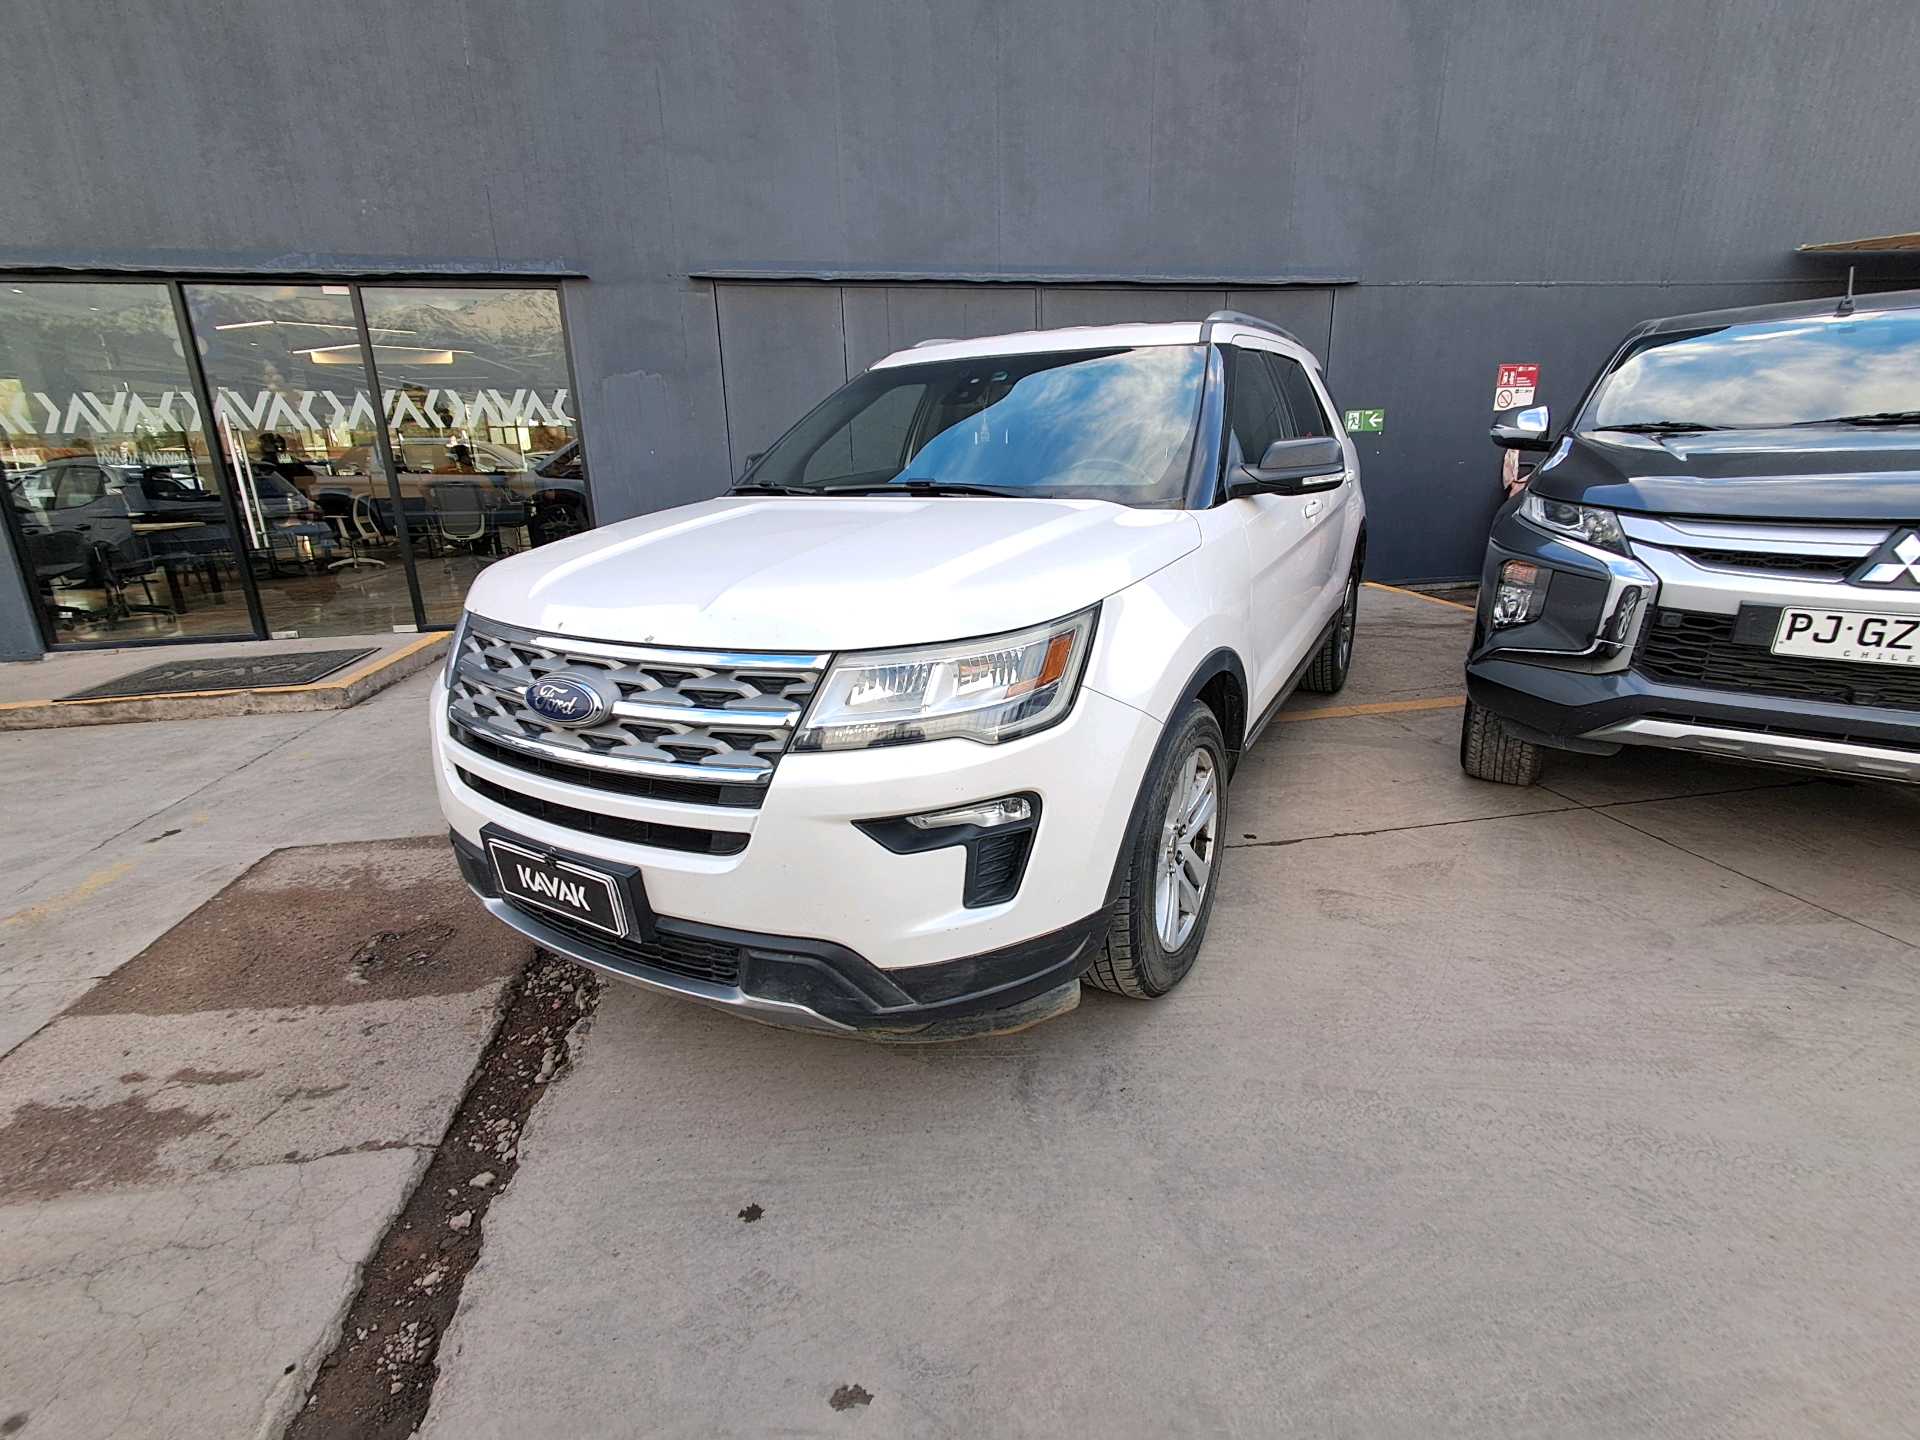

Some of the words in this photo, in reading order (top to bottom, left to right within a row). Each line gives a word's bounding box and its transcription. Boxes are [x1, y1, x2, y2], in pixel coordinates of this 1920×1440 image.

[1843, 650, 1916, 663] CHILE
[534, 683, 578, 716] Ford
[516, 863, 592, 912] KAVAK
